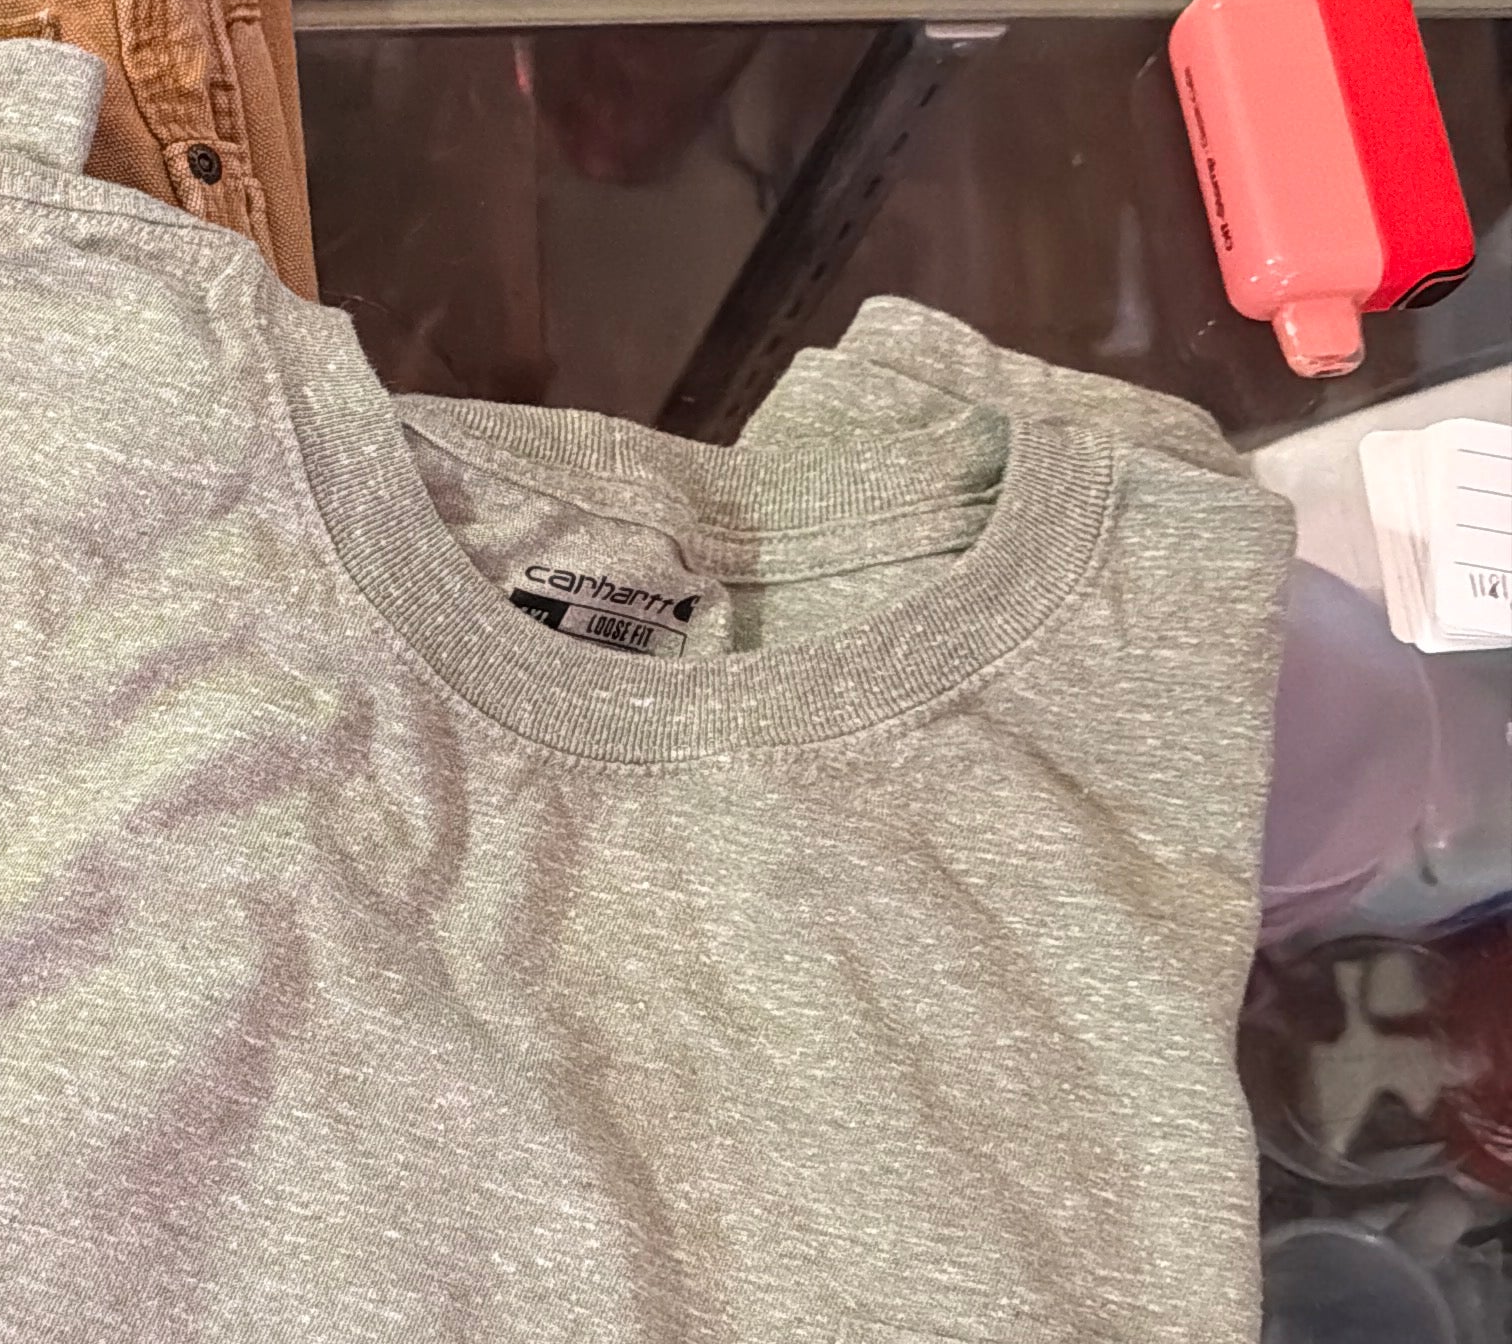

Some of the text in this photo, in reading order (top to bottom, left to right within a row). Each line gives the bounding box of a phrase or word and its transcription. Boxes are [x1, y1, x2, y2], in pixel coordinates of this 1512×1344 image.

[524, 564, 676, 615] carhartt
[587, 612, 655, 648] LOOSE FIT
